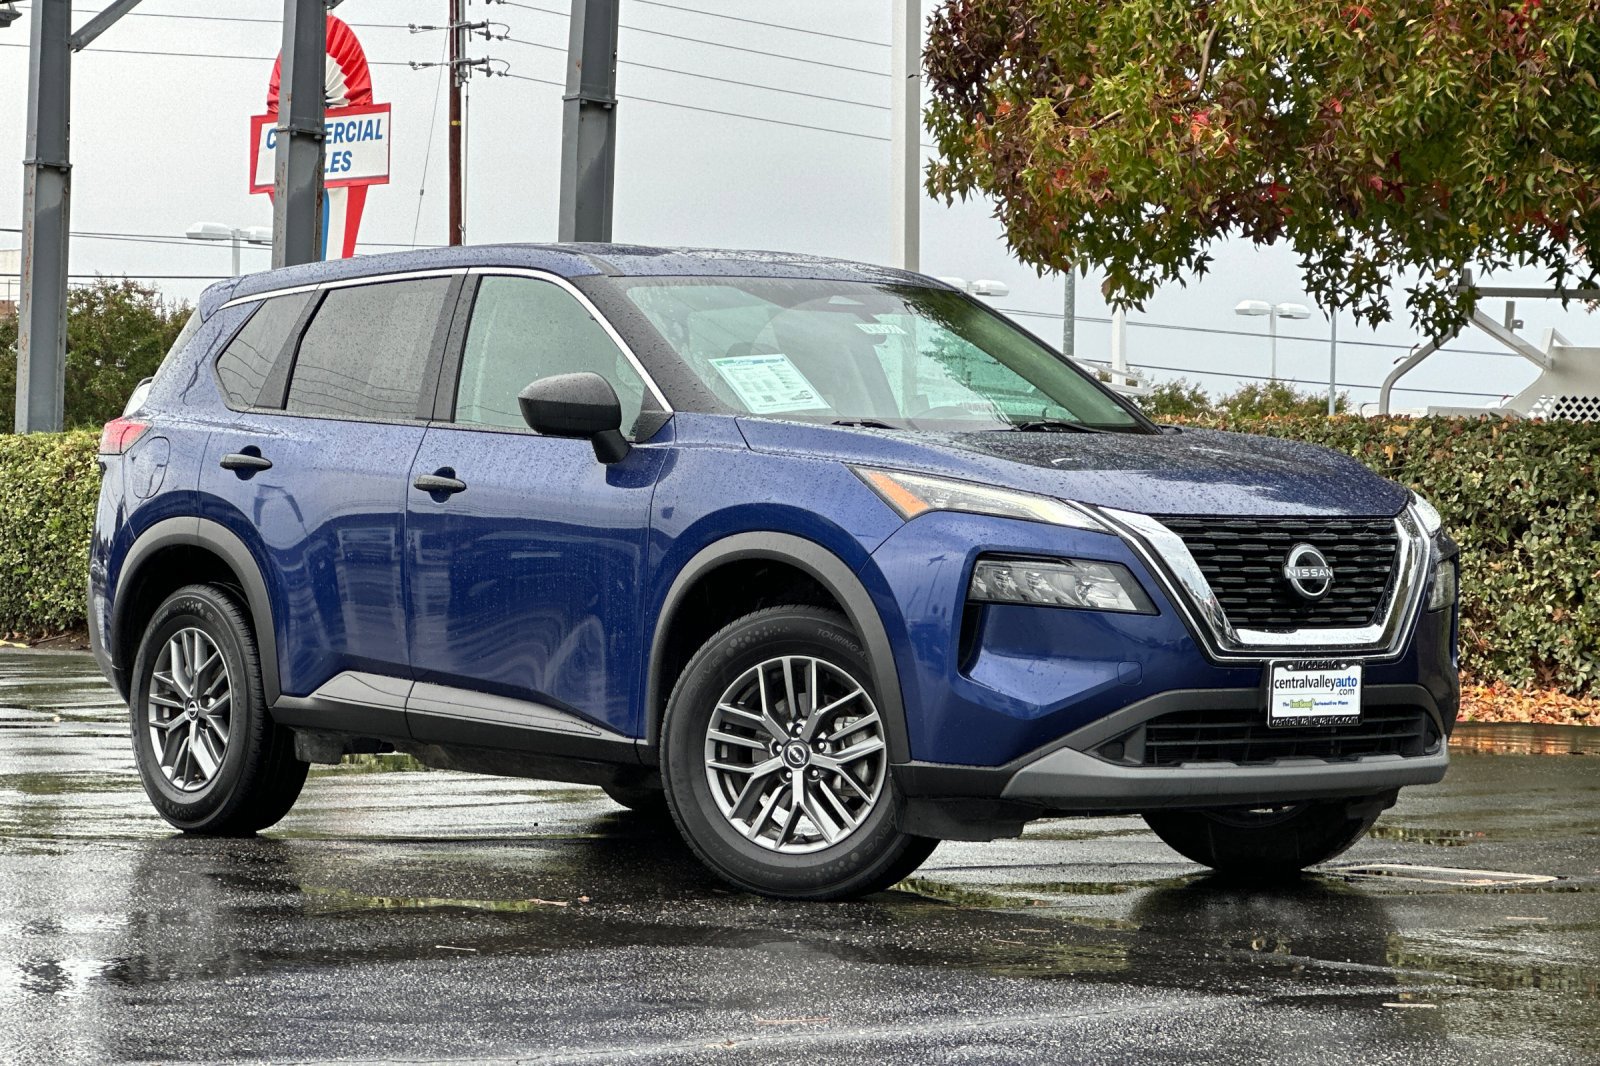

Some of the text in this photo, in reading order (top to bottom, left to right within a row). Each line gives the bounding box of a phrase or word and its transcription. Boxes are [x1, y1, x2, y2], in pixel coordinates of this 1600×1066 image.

[266, 118, 383, 149] CERCIAL
[1287, 568, 1333, 577] NISSAN
[1274, 675, 1358, 691] centralvalleyauto
[1336, 688, 1355, 696] .com
